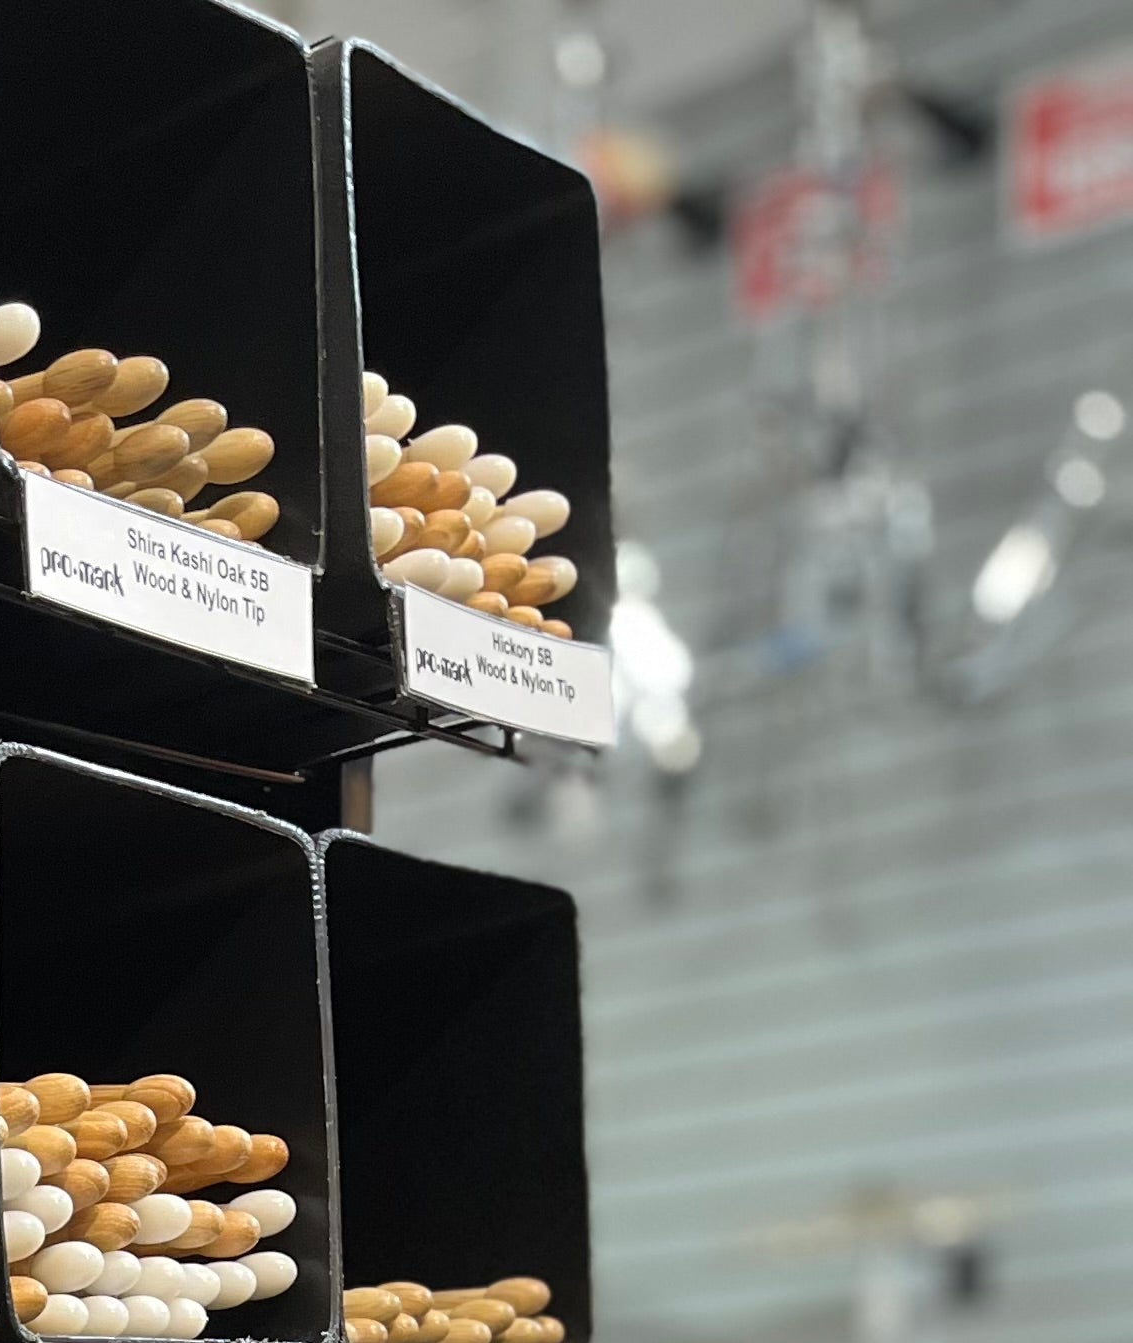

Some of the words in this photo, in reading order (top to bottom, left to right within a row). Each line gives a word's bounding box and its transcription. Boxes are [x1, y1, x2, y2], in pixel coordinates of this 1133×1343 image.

[127, 528, 166, 560] Shira
[170, 541, 213, 576] Kashi
[217, 558, 246, 584] Oak
[250, 569, 270, 593] 5B
[133, 560, 177, 597] Wood
[181, 580, 192, 601] &
[196, 582, 239, 615] Nylon
[242, 597, 266, 628] Tip
[492, 632, 534, 666] Hickory
[538, 647, 553, 667] 5B
[476, 655, 507, 681] Wood
[510, 666, 518, 685] &
[522, 669, 554, 697] Nylon
[556, 678, 576, 704] Tip
